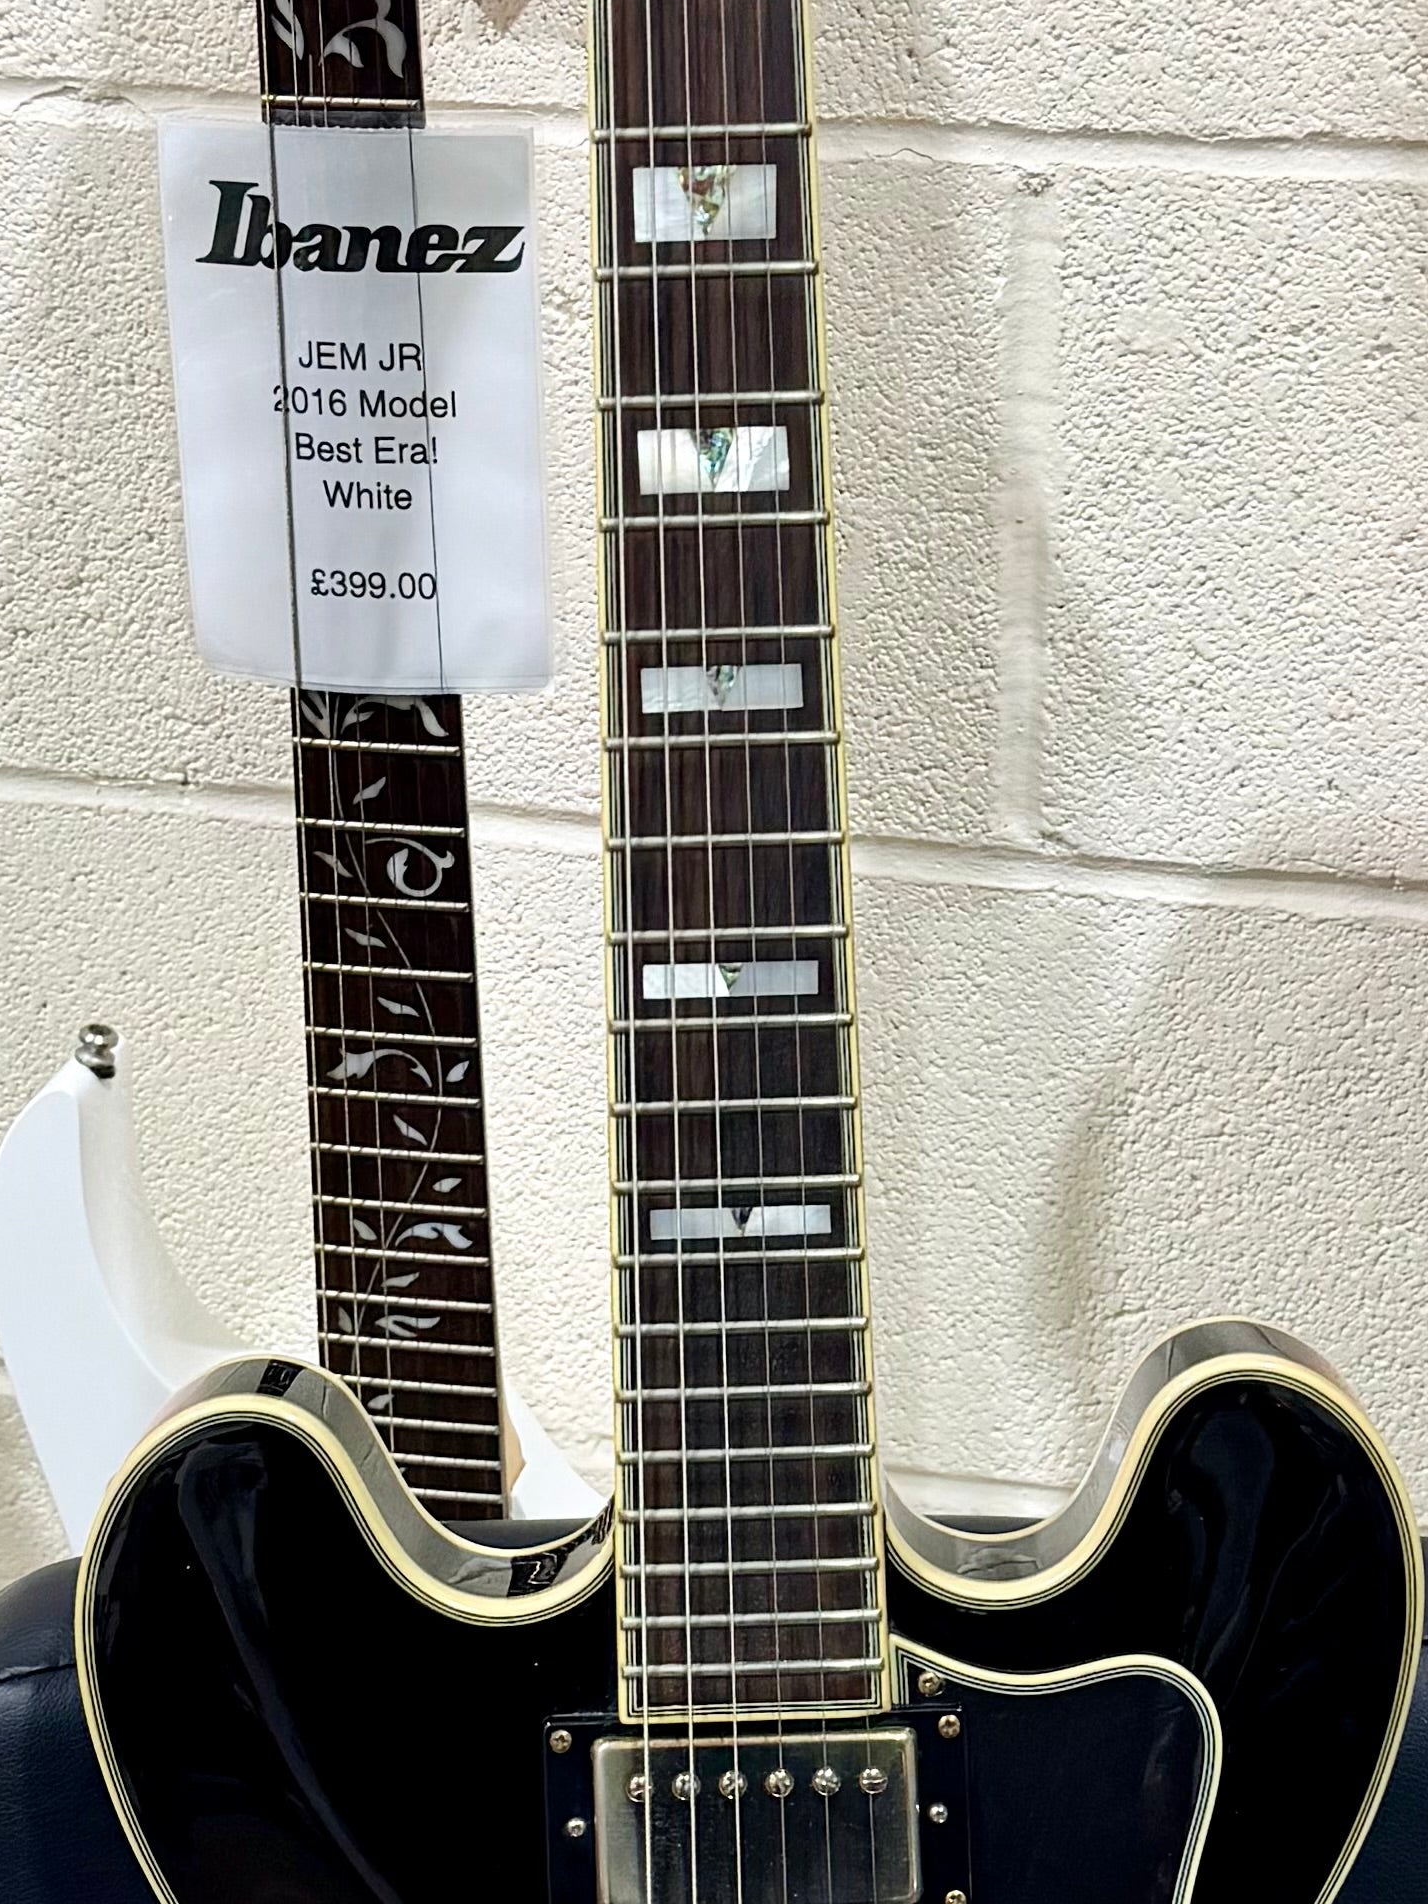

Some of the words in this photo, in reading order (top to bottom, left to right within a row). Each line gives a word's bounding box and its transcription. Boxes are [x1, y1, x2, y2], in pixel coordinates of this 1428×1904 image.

[196, 179, 526, 273] Ibanez
[298, 341, 367, 371] JEM
[378, 342, 423, 373] JR
[272, 385, 347, 417] 2016
[359, 390, 457, 419] Model
[295, 433, 364, 464] Best
[373, 437, 439, 465] Era!
[323, 480, 413, 511] White
[310, 569, 437, 601] £399.00
